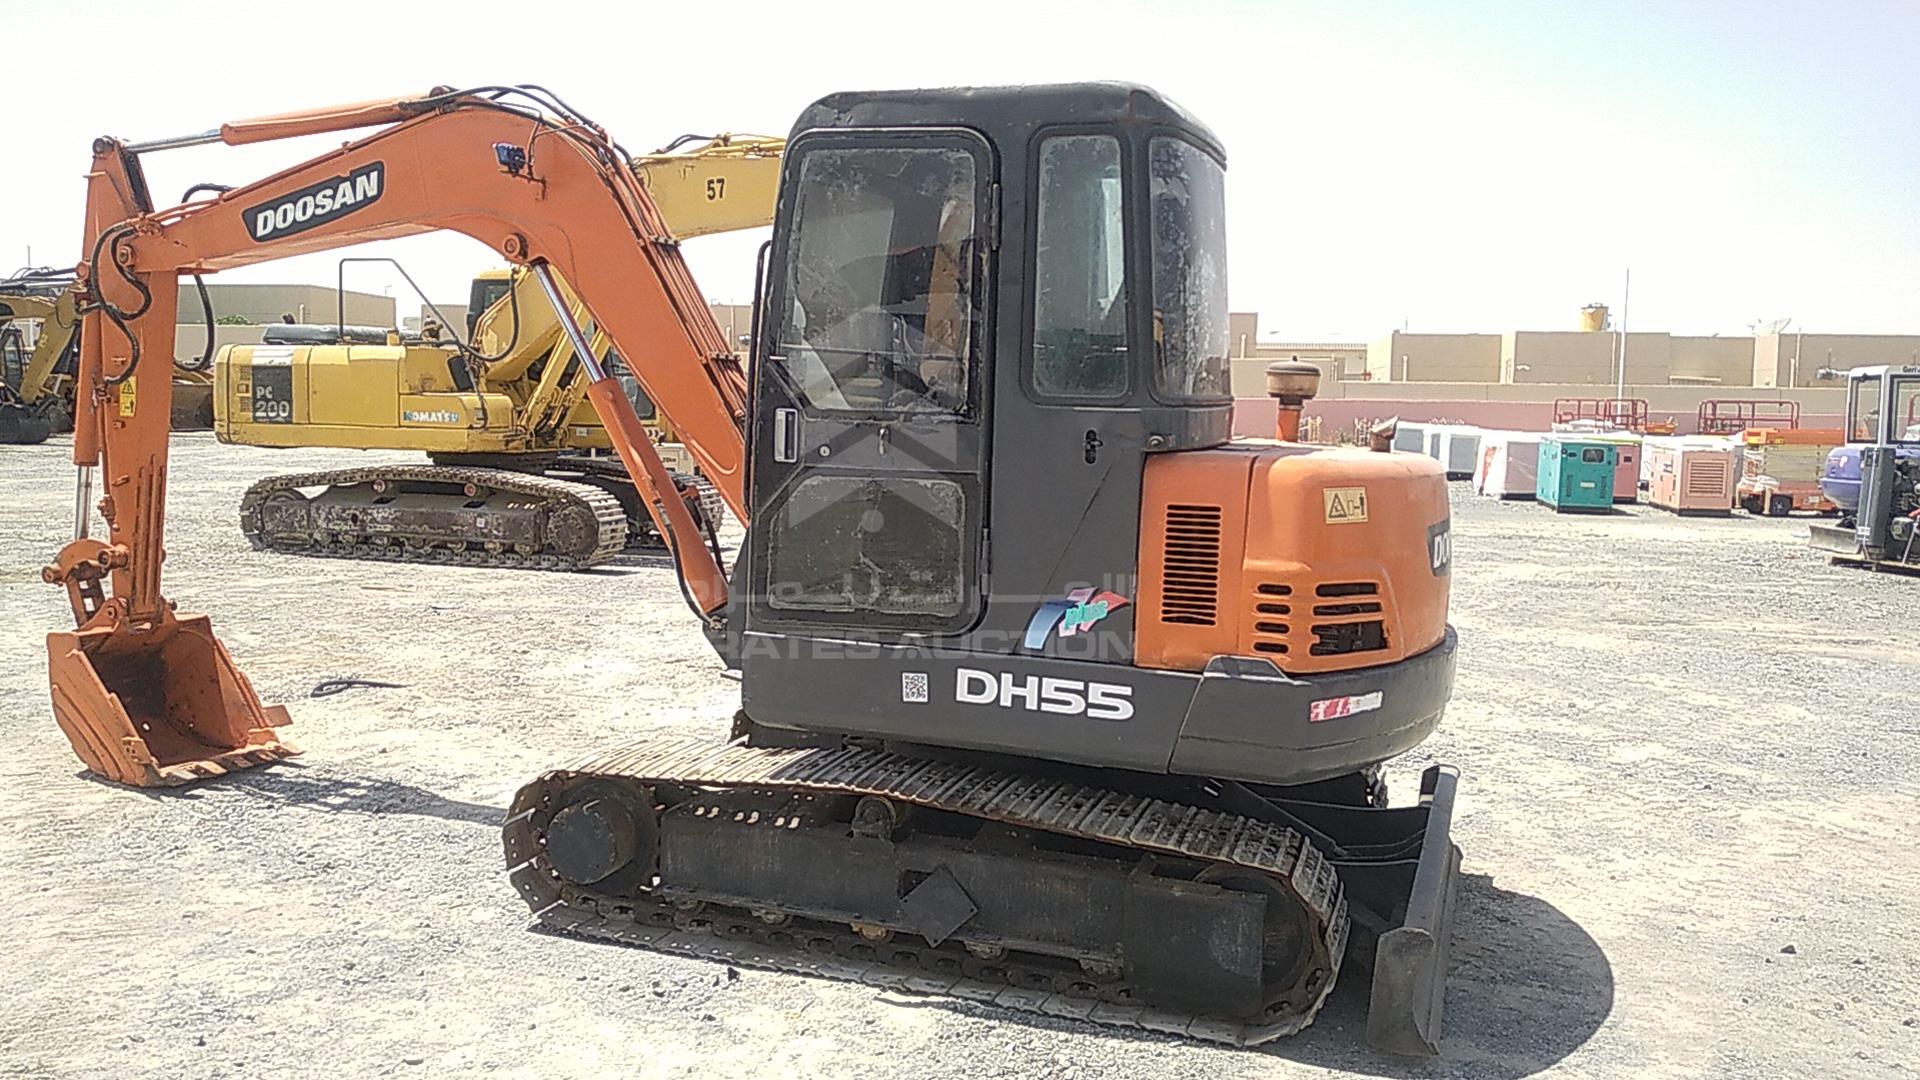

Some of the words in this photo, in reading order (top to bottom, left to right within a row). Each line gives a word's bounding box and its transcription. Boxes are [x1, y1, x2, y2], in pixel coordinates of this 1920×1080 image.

[706, 178, 725, 200] 57
[256, 171, 378, 238] DOOSAN
[256, 386, 273, 399] PC
[255, 401, 290, 417] 200
[956, 668, 1135, 720] DH55
